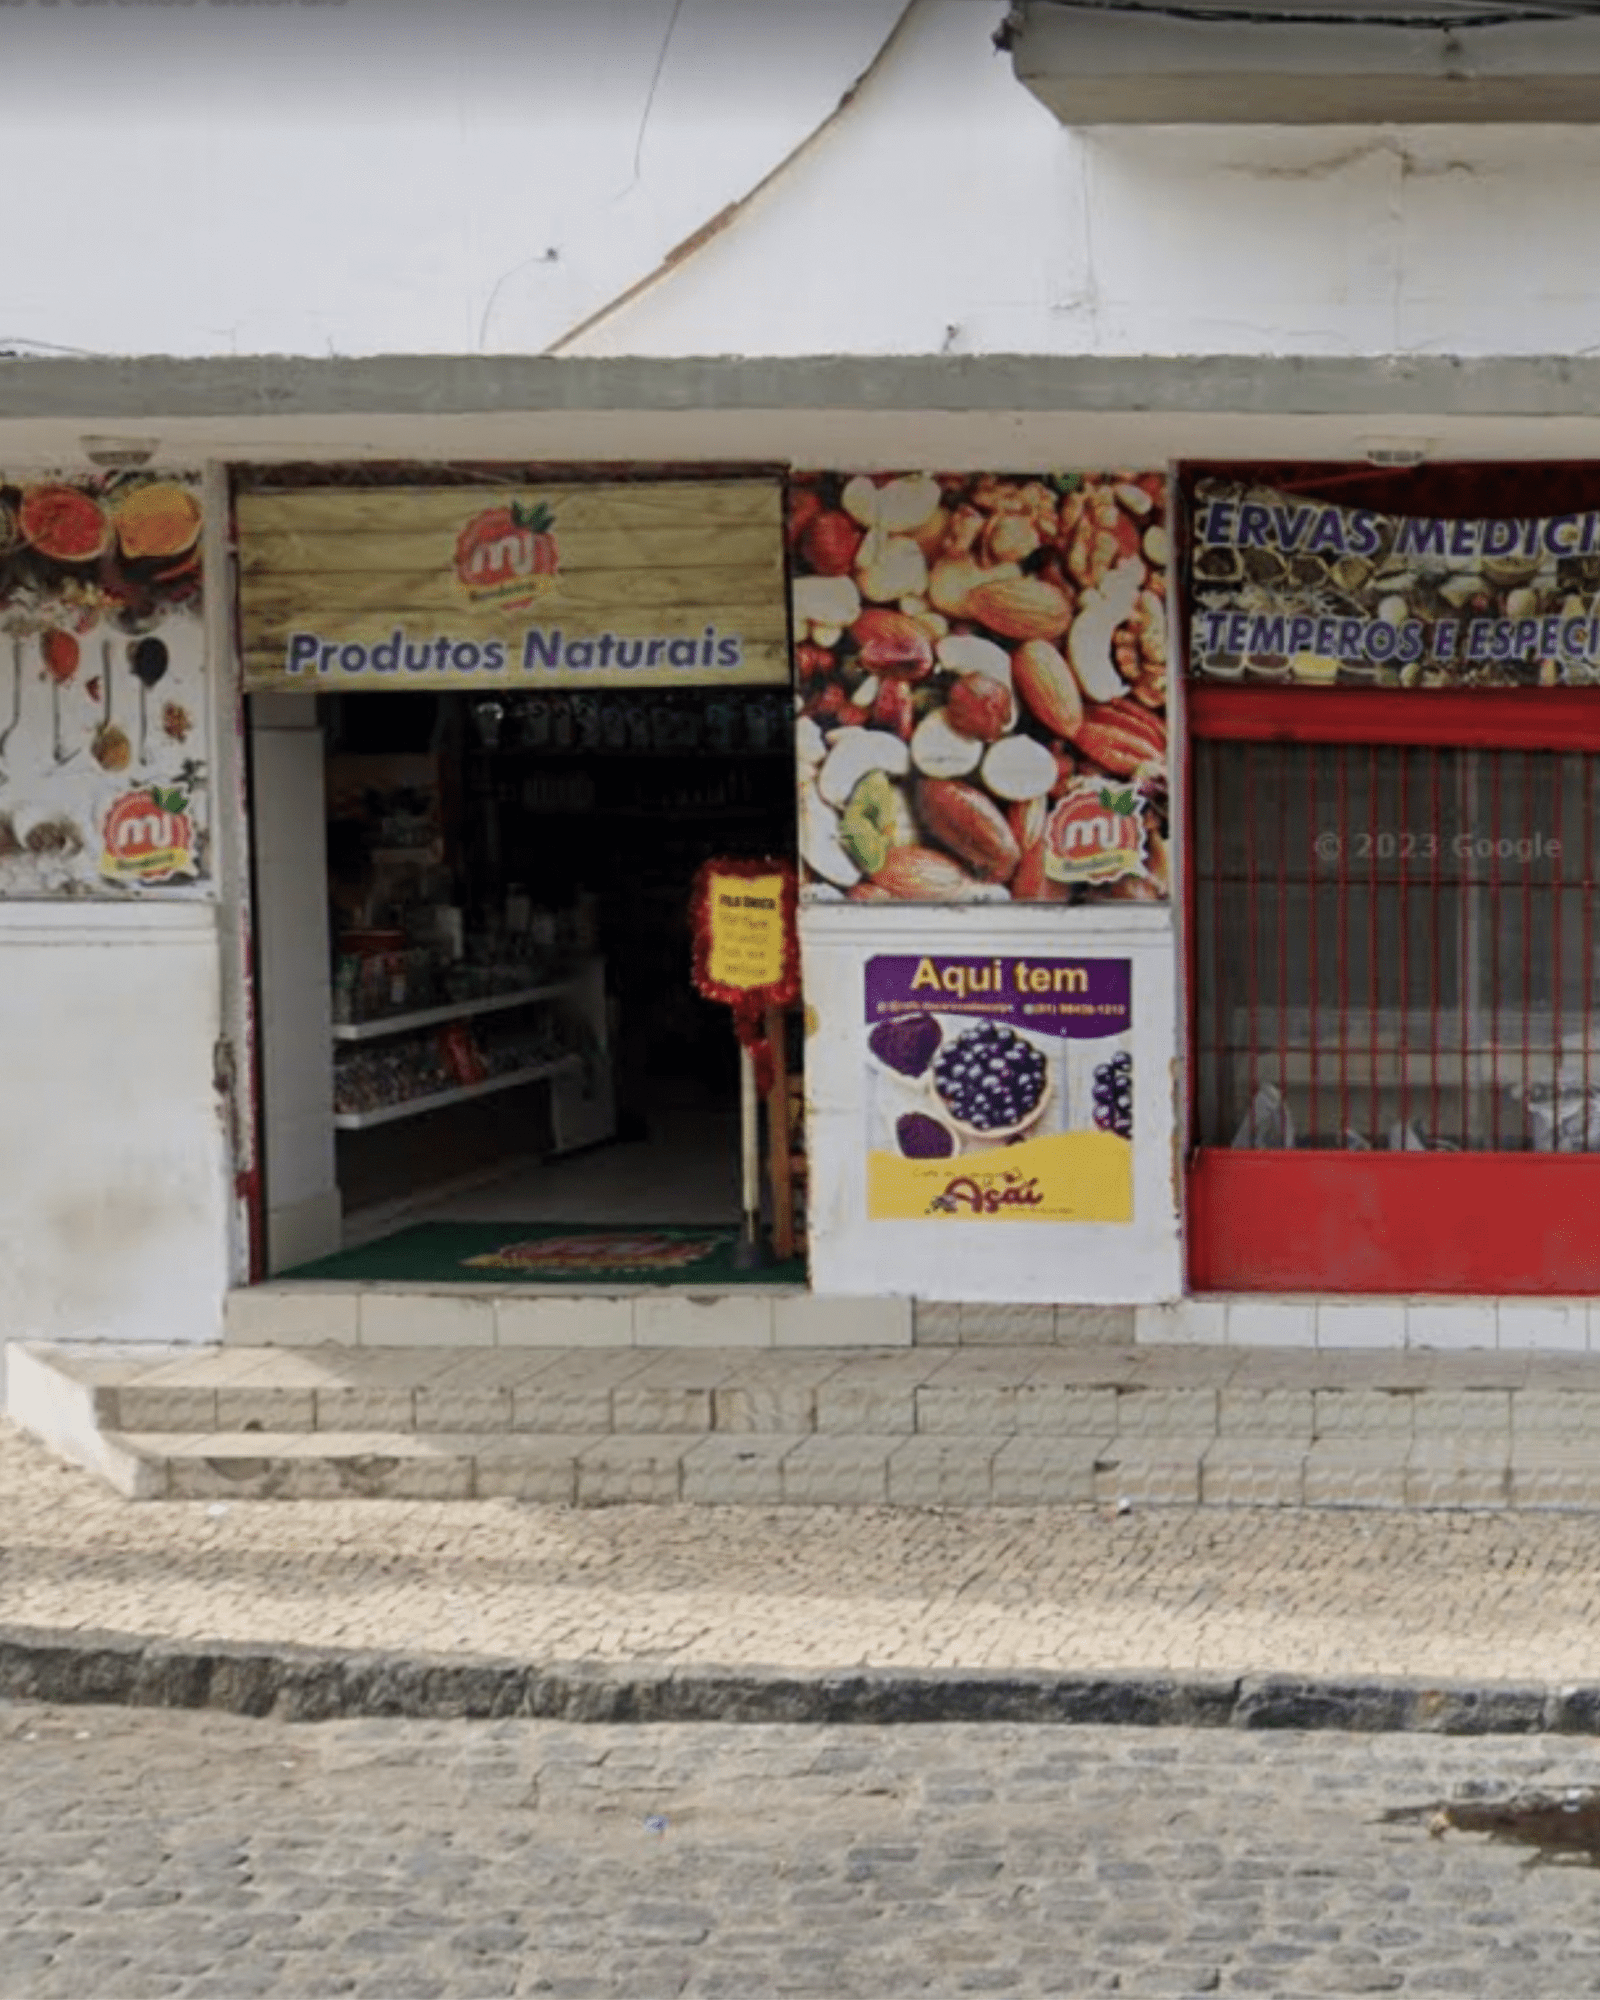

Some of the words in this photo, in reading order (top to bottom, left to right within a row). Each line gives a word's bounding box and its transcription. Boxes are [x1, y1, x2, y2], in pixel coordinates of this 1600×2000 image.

[1205, 502, 1380, 554] ERVAS
[288, 627, 504, 674] Produtos
[523, 625, 741, 670] Naturais
[1205, 614, 1424, 660] TEMPEROS
[1434, 618, 1457, 658] E
[1469, 616, 1600, 660] ESPECI
[910, 957, 1003, 998] Aqui
[1012, 961, 1089, 993] tem
